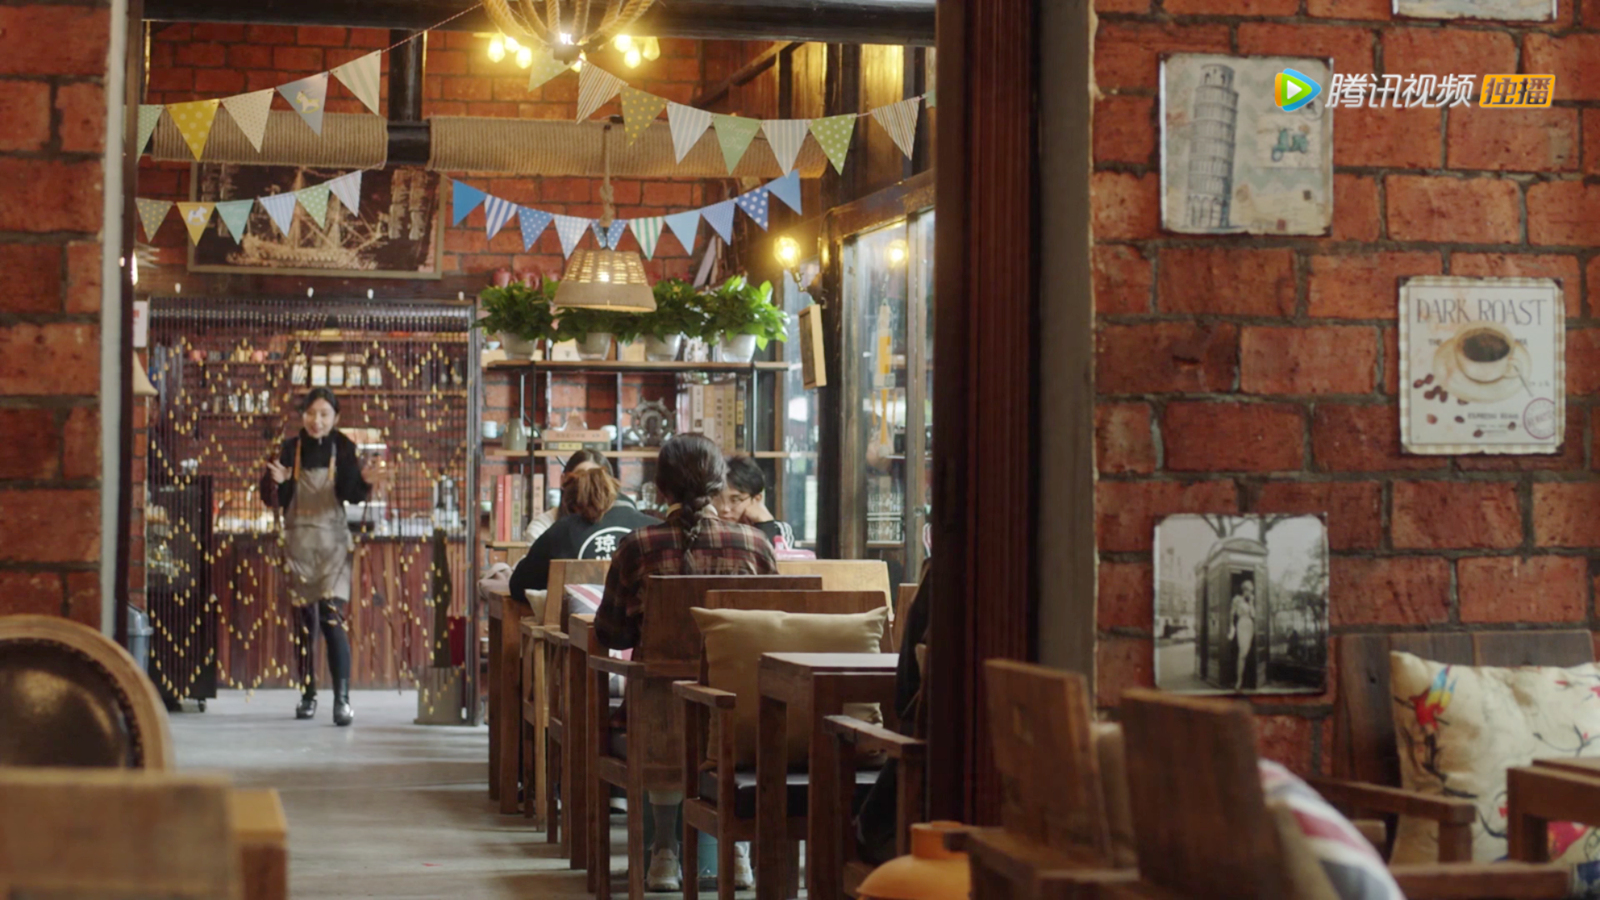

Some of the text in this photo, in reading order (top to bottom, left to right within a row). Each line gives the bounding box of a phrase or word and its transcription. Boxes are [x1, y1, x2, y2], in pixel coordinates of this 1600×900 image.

[1416, 298, 1547, 326] DARK ROAST
[594, 533, 617, 560] 琼
